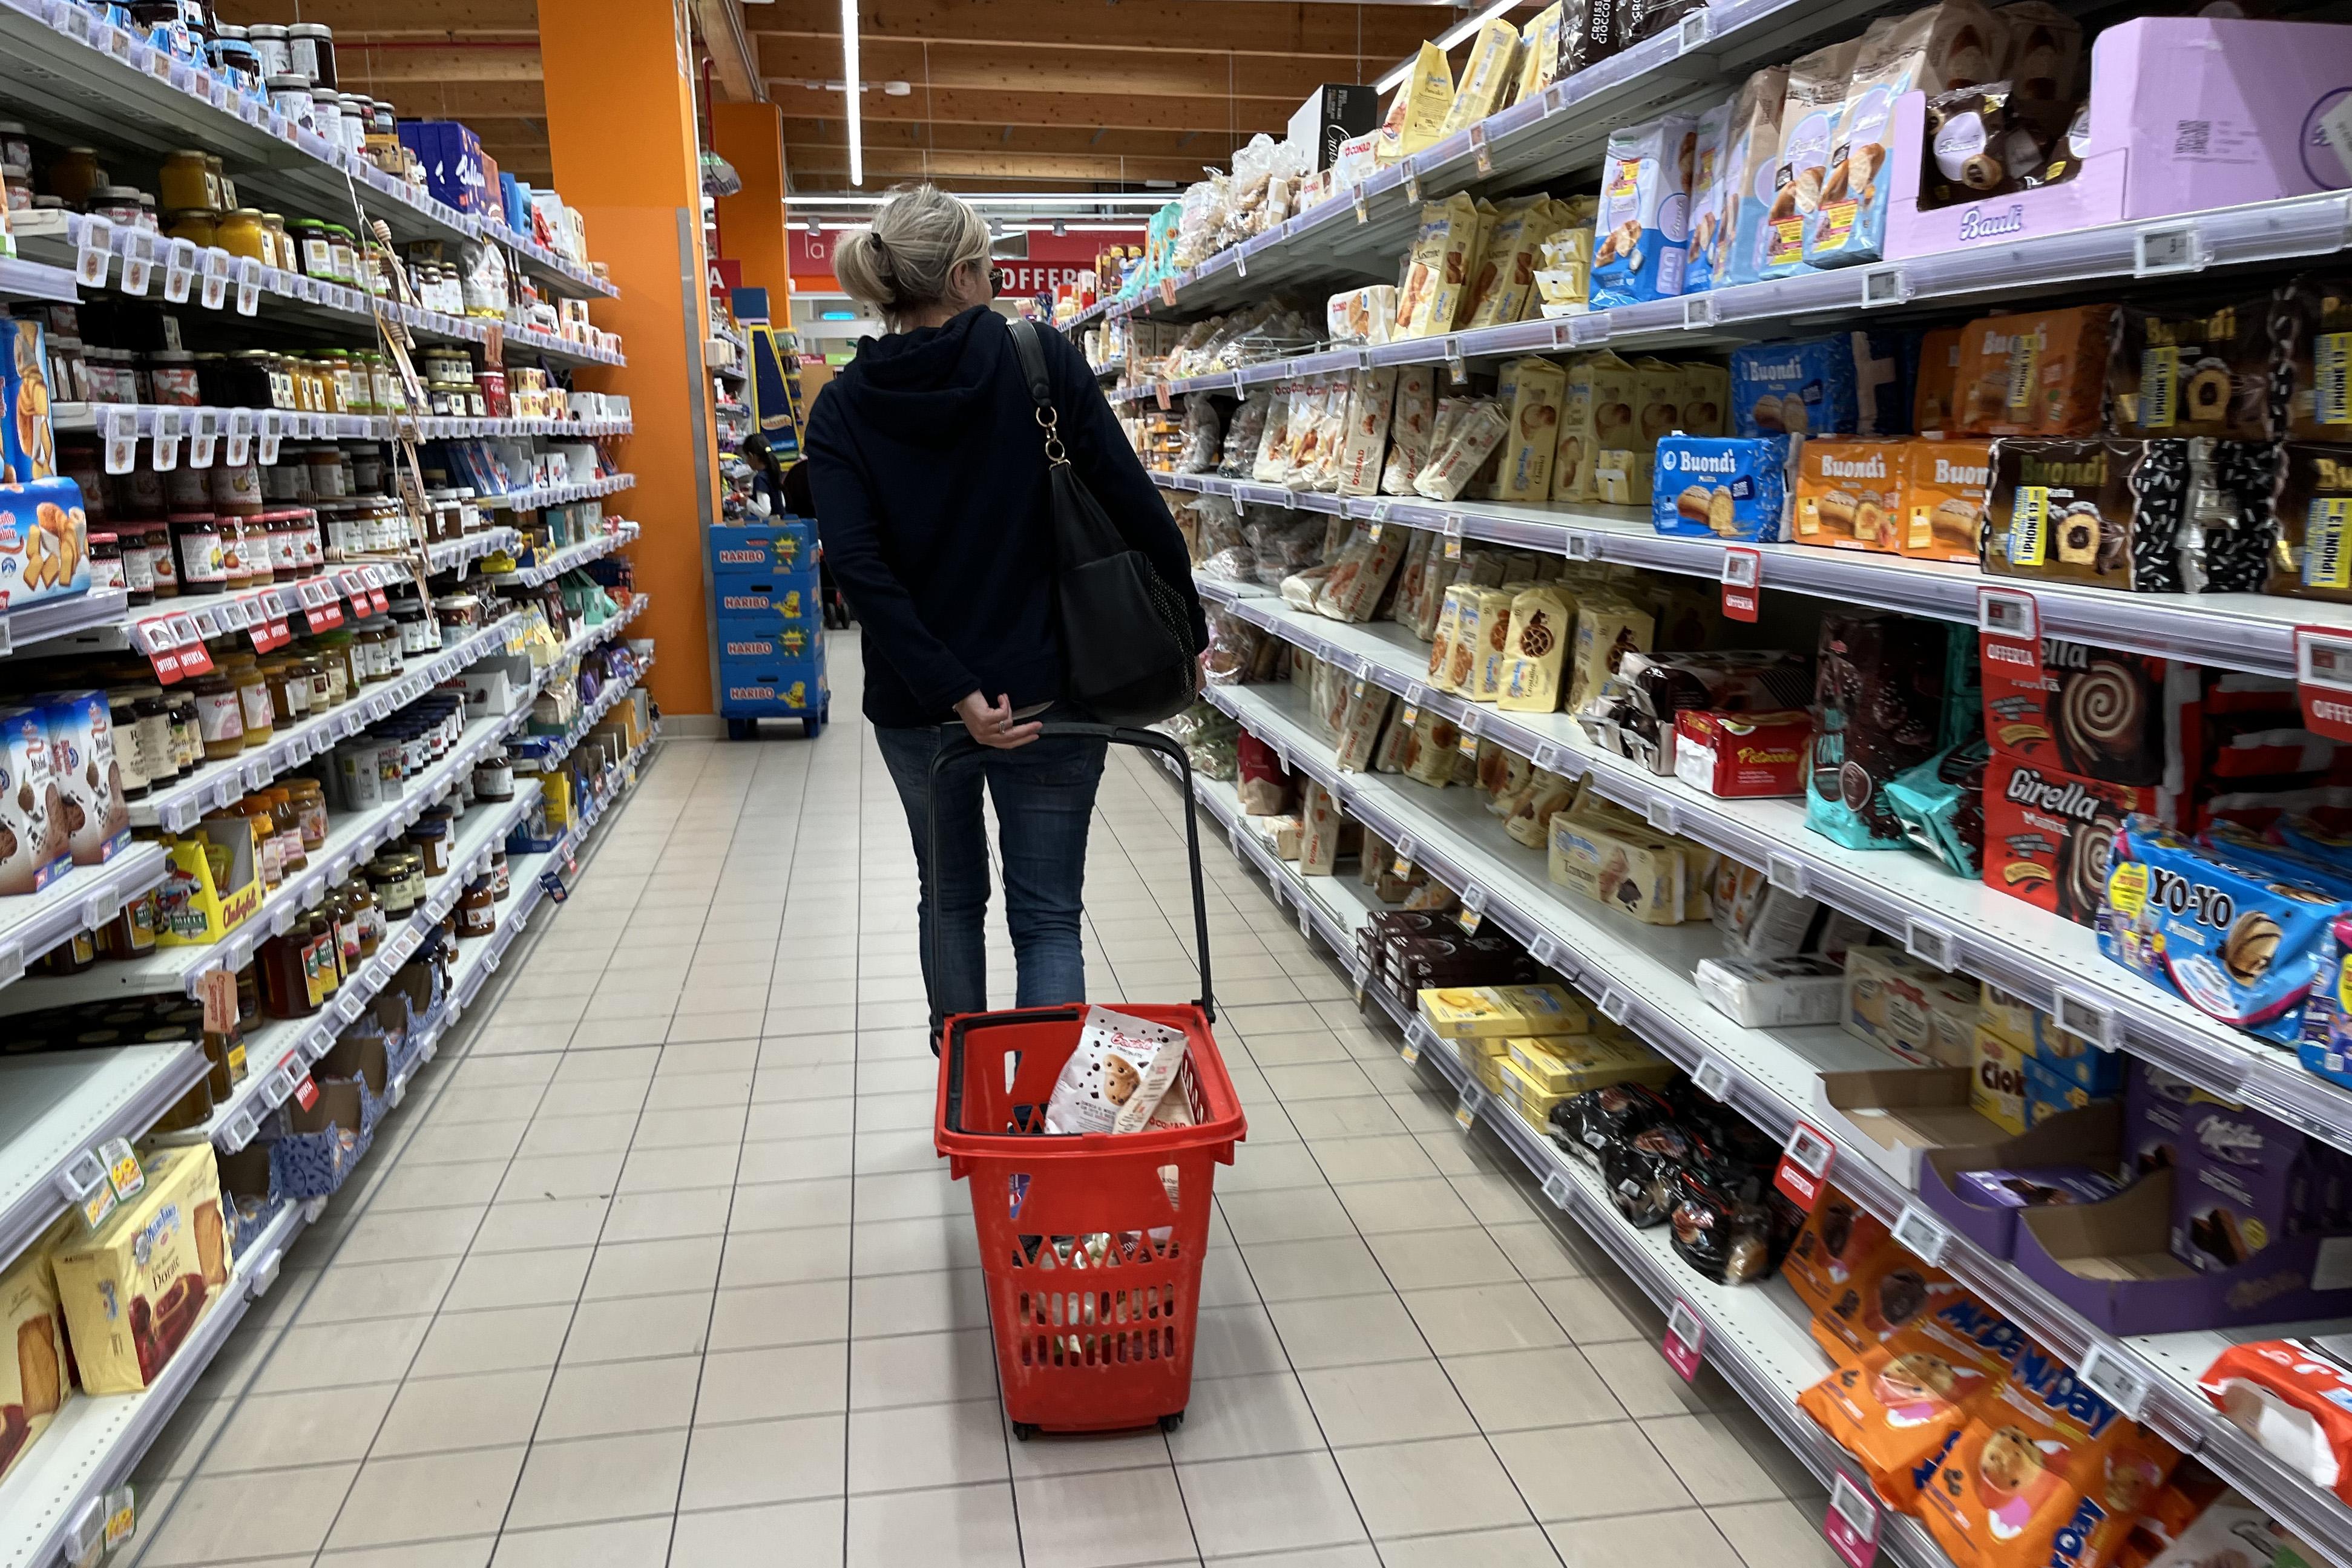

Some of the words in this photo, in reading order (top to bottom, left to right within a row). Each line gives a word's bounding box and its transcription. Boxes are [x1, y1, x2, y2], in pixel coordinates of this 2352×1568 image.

[1959, 204, 2024, 241] Bauli
[2334, 367, 2345, 410] IPHONE
[1353, 449, 1364, 478] CONAD
[2029, 502, 2038, 512] 13
[2023, 516, 2038, 553] IPHONE
[720, 550, 766, 563] HARIBO
[2322, 531, 2341, 574] IPHONE
[724, 596, 770, 609] HARIBO
[271, 624, 289, 638] OFFERTA
[180, 651, 206, 667] OFFERTA
[728, 642, 773, 655] HARIBO
[1986, 643, 2035, 667] OFFERTA
[156, 656, 179, 674] OFFERTA
[731, 687, 775, 700] HARIBO
[2006, 768, 2100, 821] Girella
[2149, 865, 2235, 931] YO-YO
[153, 1256, 180, 1291] Dorate
